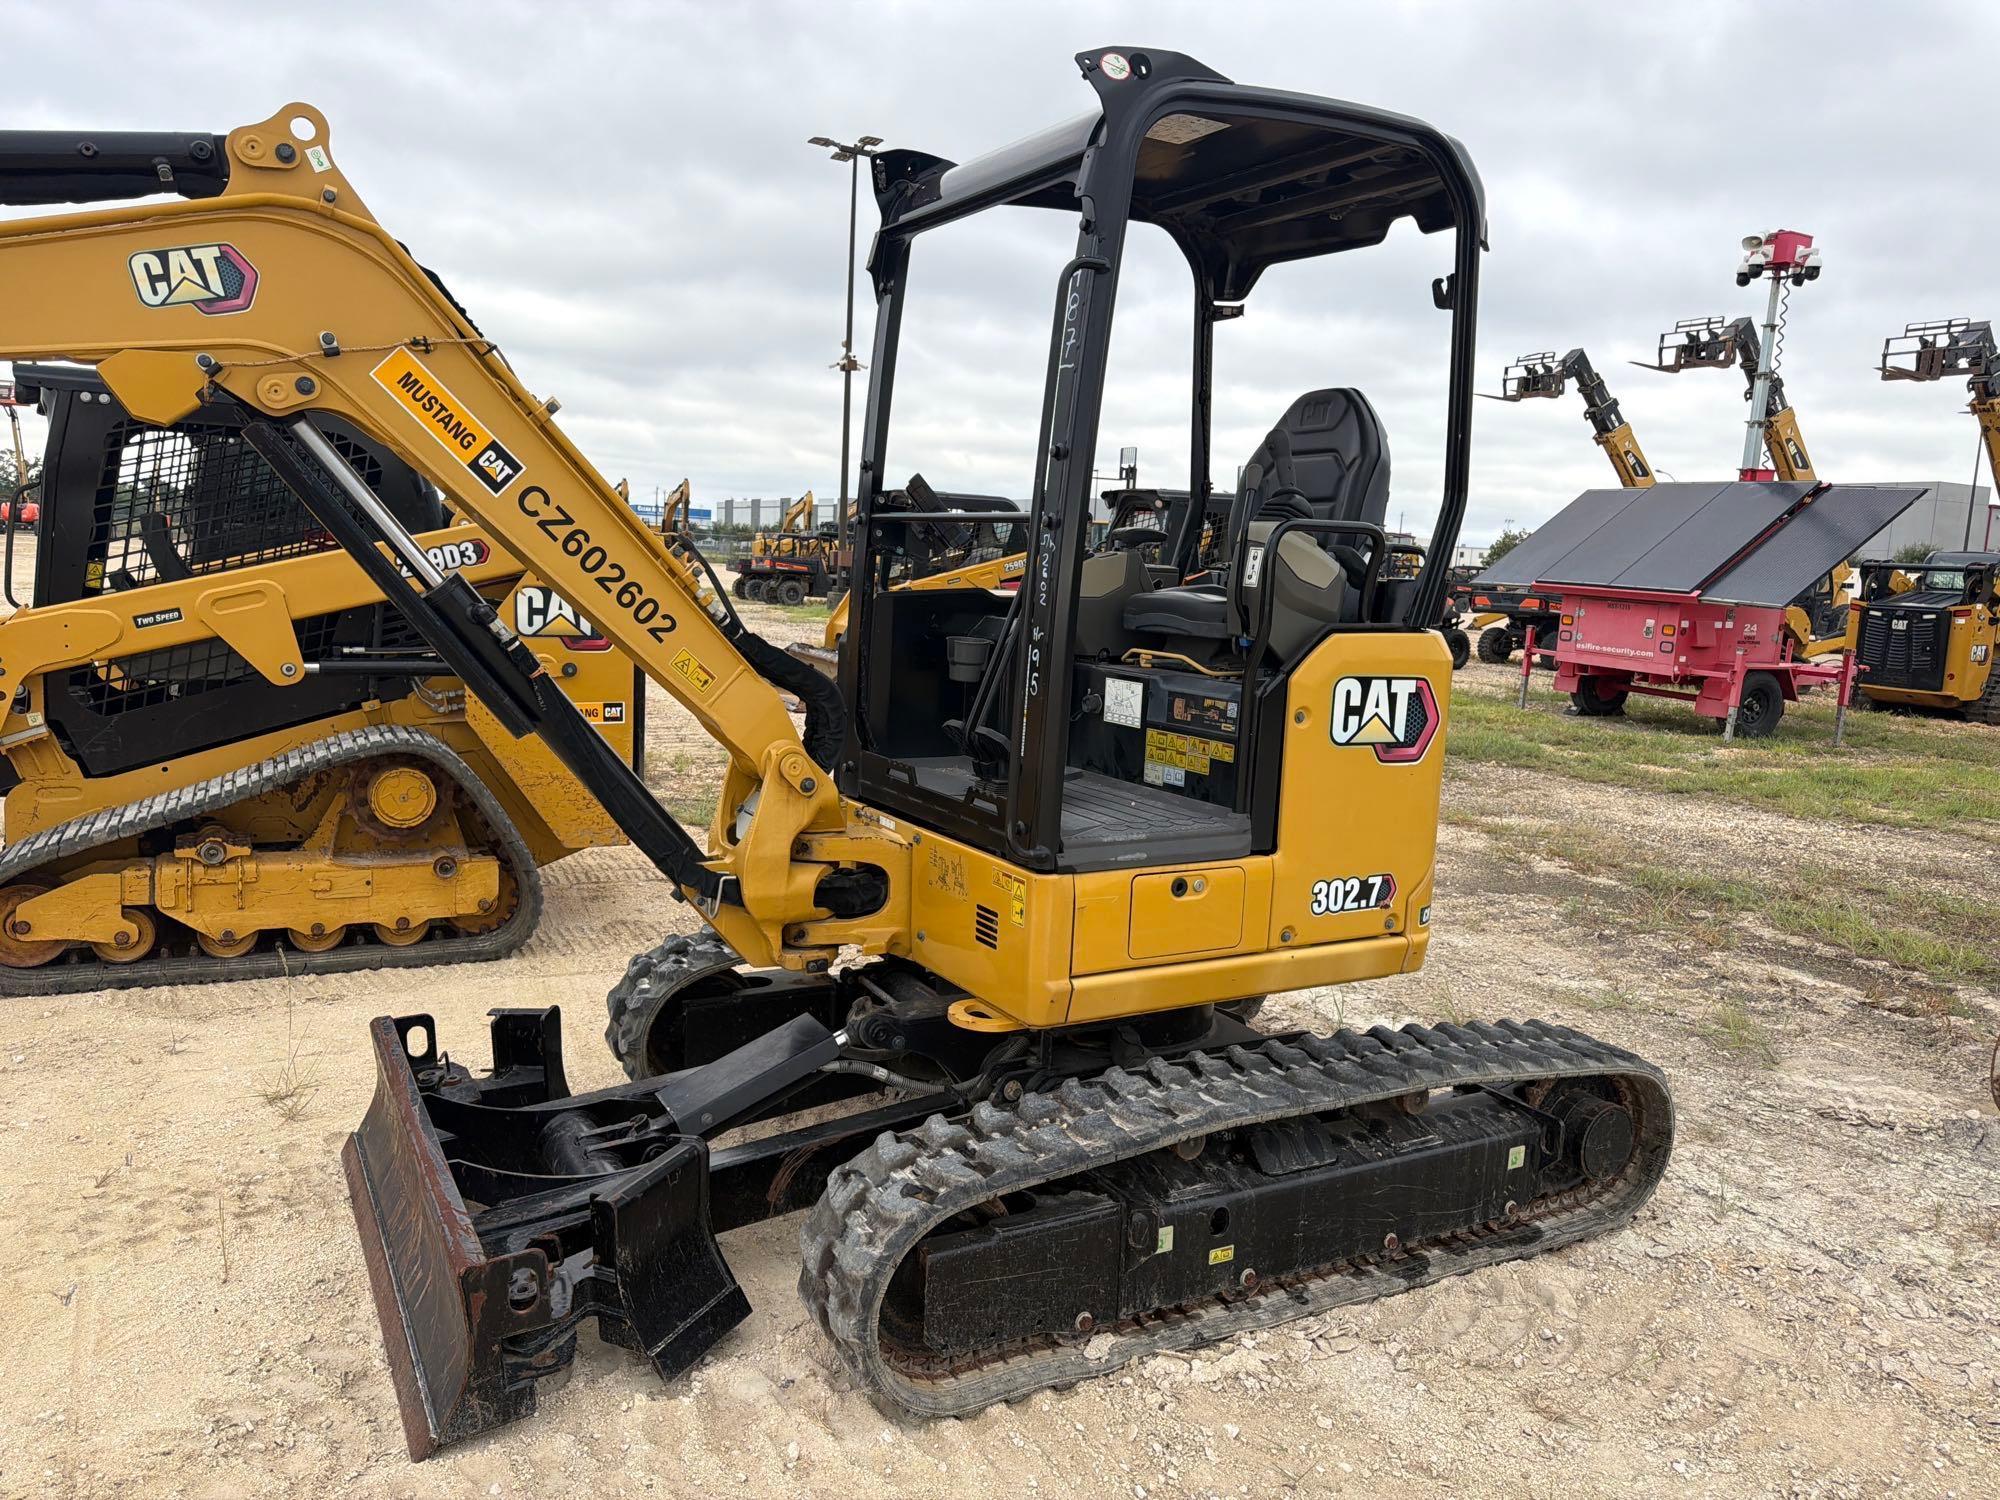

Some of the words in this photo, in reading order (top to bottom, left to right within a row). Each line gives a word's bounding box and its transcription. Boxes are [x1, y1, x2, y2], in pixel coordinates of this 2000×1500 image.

[130, 245, 226, 306] CAT
[396, 370, 478, 451] MUSTANG
[478, 449, 513, 483] CAT
[517, 485, 678, 644] CZ602602
[1039, 553, 1049, 606] 2602
[1743, 623, 1757, 632] 24
[1892, 619, 1909, 630] CAT
[1576, 642, 1654, 658] esifire-security.com
[1970, 645, 1987, 662] CAT
[604, 707, 622, 718] CAT
[1332, 677, 1417, 744] CAT
[1312, 875, 1383, 914] 302.7
